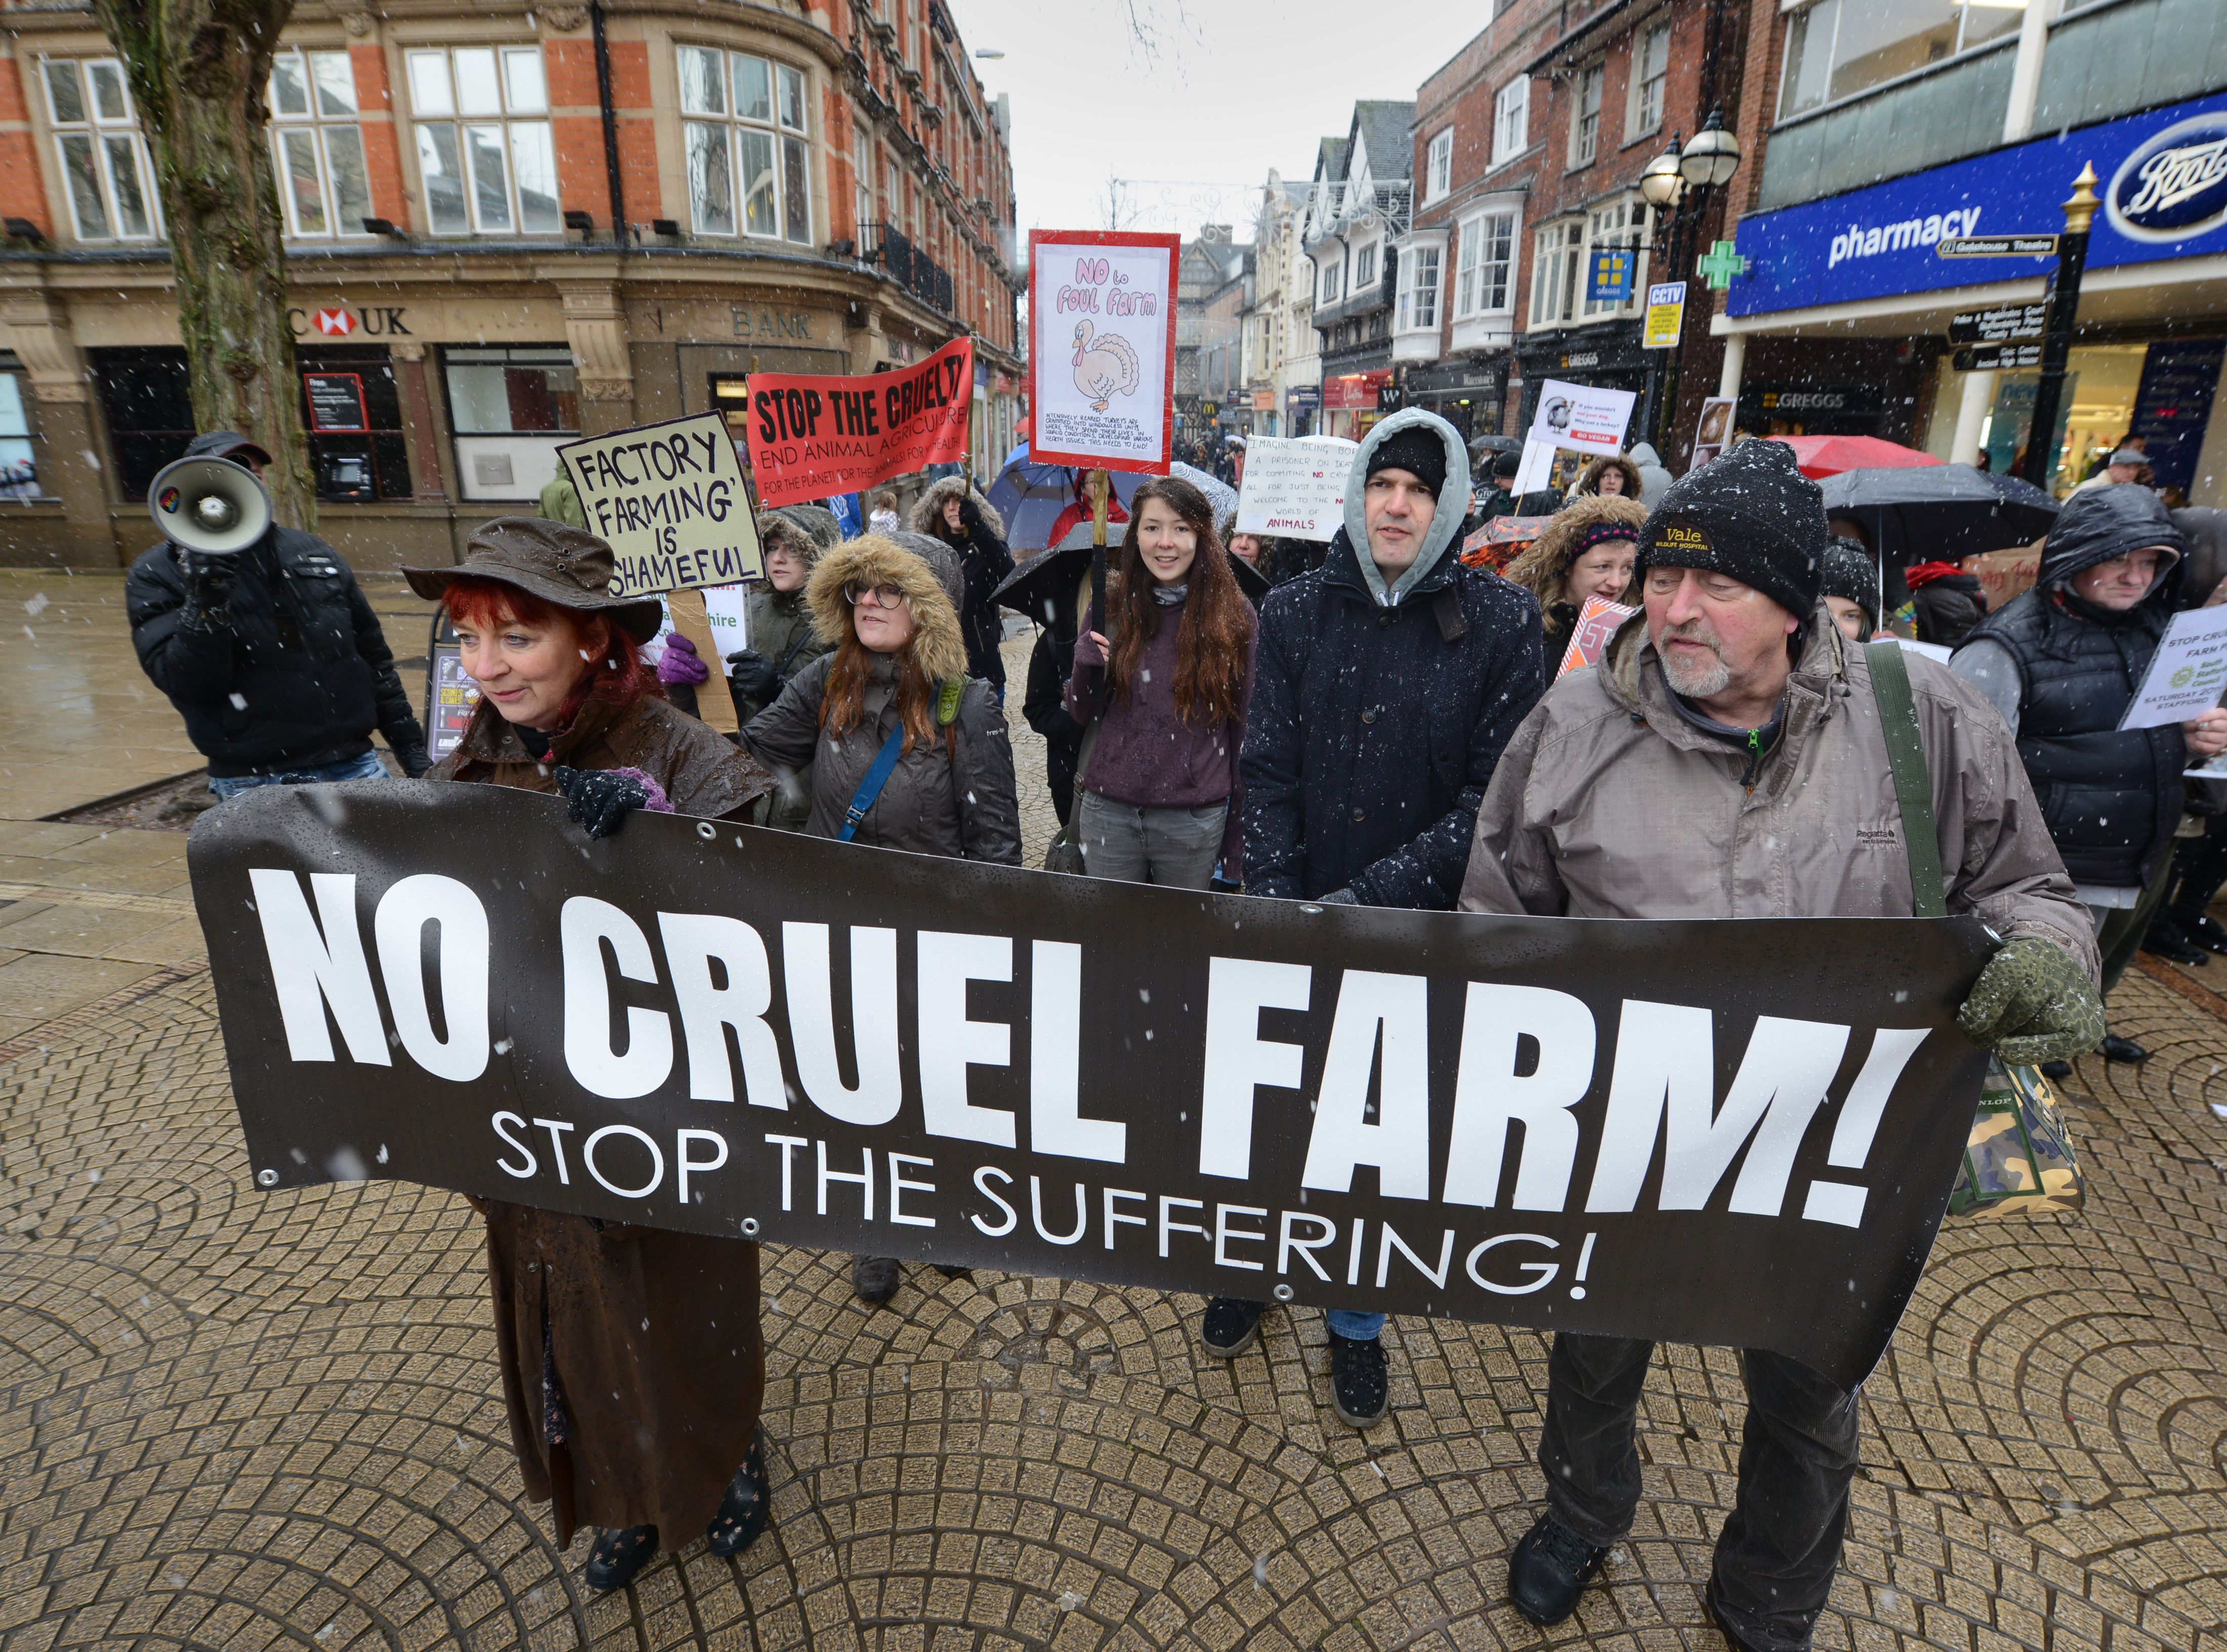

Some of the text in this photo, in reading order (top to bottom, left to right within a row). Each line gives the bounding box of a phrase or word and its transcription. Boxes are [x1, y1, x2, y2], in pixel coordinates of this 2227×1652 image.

[1828, 205, 1982, 270] pharmacy
[1956, 240, 2052, 253] Gatehouse Theatre
[1076, 258, 1129, 285] NO to
[1652, 286, 1682, 304] CCTV
[357, 307, 412, 335] UK
[1953, 315, 1973, 325] Police
[2025, 306, 2046, 317] Court
[2024, 316, 2044, 326] Place
[733, 309, 812, 339] BANK
[1984, 326, 2042, 340] County Buildings
[2000, 346, 2040, 357] Civic Centre
[1568, 352, 1598, 368] GREGGS
[1976, 356, 2039, 369] Ancient High House
[309, 378, 327, 387] Free
[1344, 380, 1363, 401] Clintons
[1383, 390, 1399, 403] W
[755, 353, 966, 444] STOP THE CRUELTY
[1780, 393, 1845, 408] GREGGS
[760, 446, 798, 469] END
[805, 440, 875, 462] ANIMAL
[879, 406, 966, 455] AGRICULURE
[1302, 442, 1328, 455] BEING
[1338, 446, 1357, 455] BOR
[575, 432, 716, 492] FACTORY
[764, 481, 783, 494] FOR
[784, 477, 800, 491] THE
[802, 470, 835, 487] PLANET!
[837, 468, 854, 480] FOR
[856, 467, 872, 479] THE
[874, 450, 906, 477] ANIMALS!
[908, 446, 924, 459] FOR
[932, 436, 961, 450] HEALTH!
[1271, 456, 1310, 465] PRISONER
[1317, 483, 1340, 491] BEING
[1266, 518, 1315, 530] ANIMALS
[655, 526, 677, 556] IS
[1667, 528, 1702, 542] Vale
[609, 547, 757, 597] SHAMEFUL
[2168, 635, 2200, 648] STOP
[2186, 645, 2218, 658] FARM
[440, 688, 463, 696] SCONES
[2144, 690, 2198, 704] SATURDAY
[445, 696, 462, 705] CAKES
[2157, 697, 2209, 710] STAFFORD
[1856, 830, 1887, 839] Regatta
[248, 868, 1933, 1229] NO CRUEL FARM!
[491, 1110, 1597, 1300] STOP THE SUFFERING!
